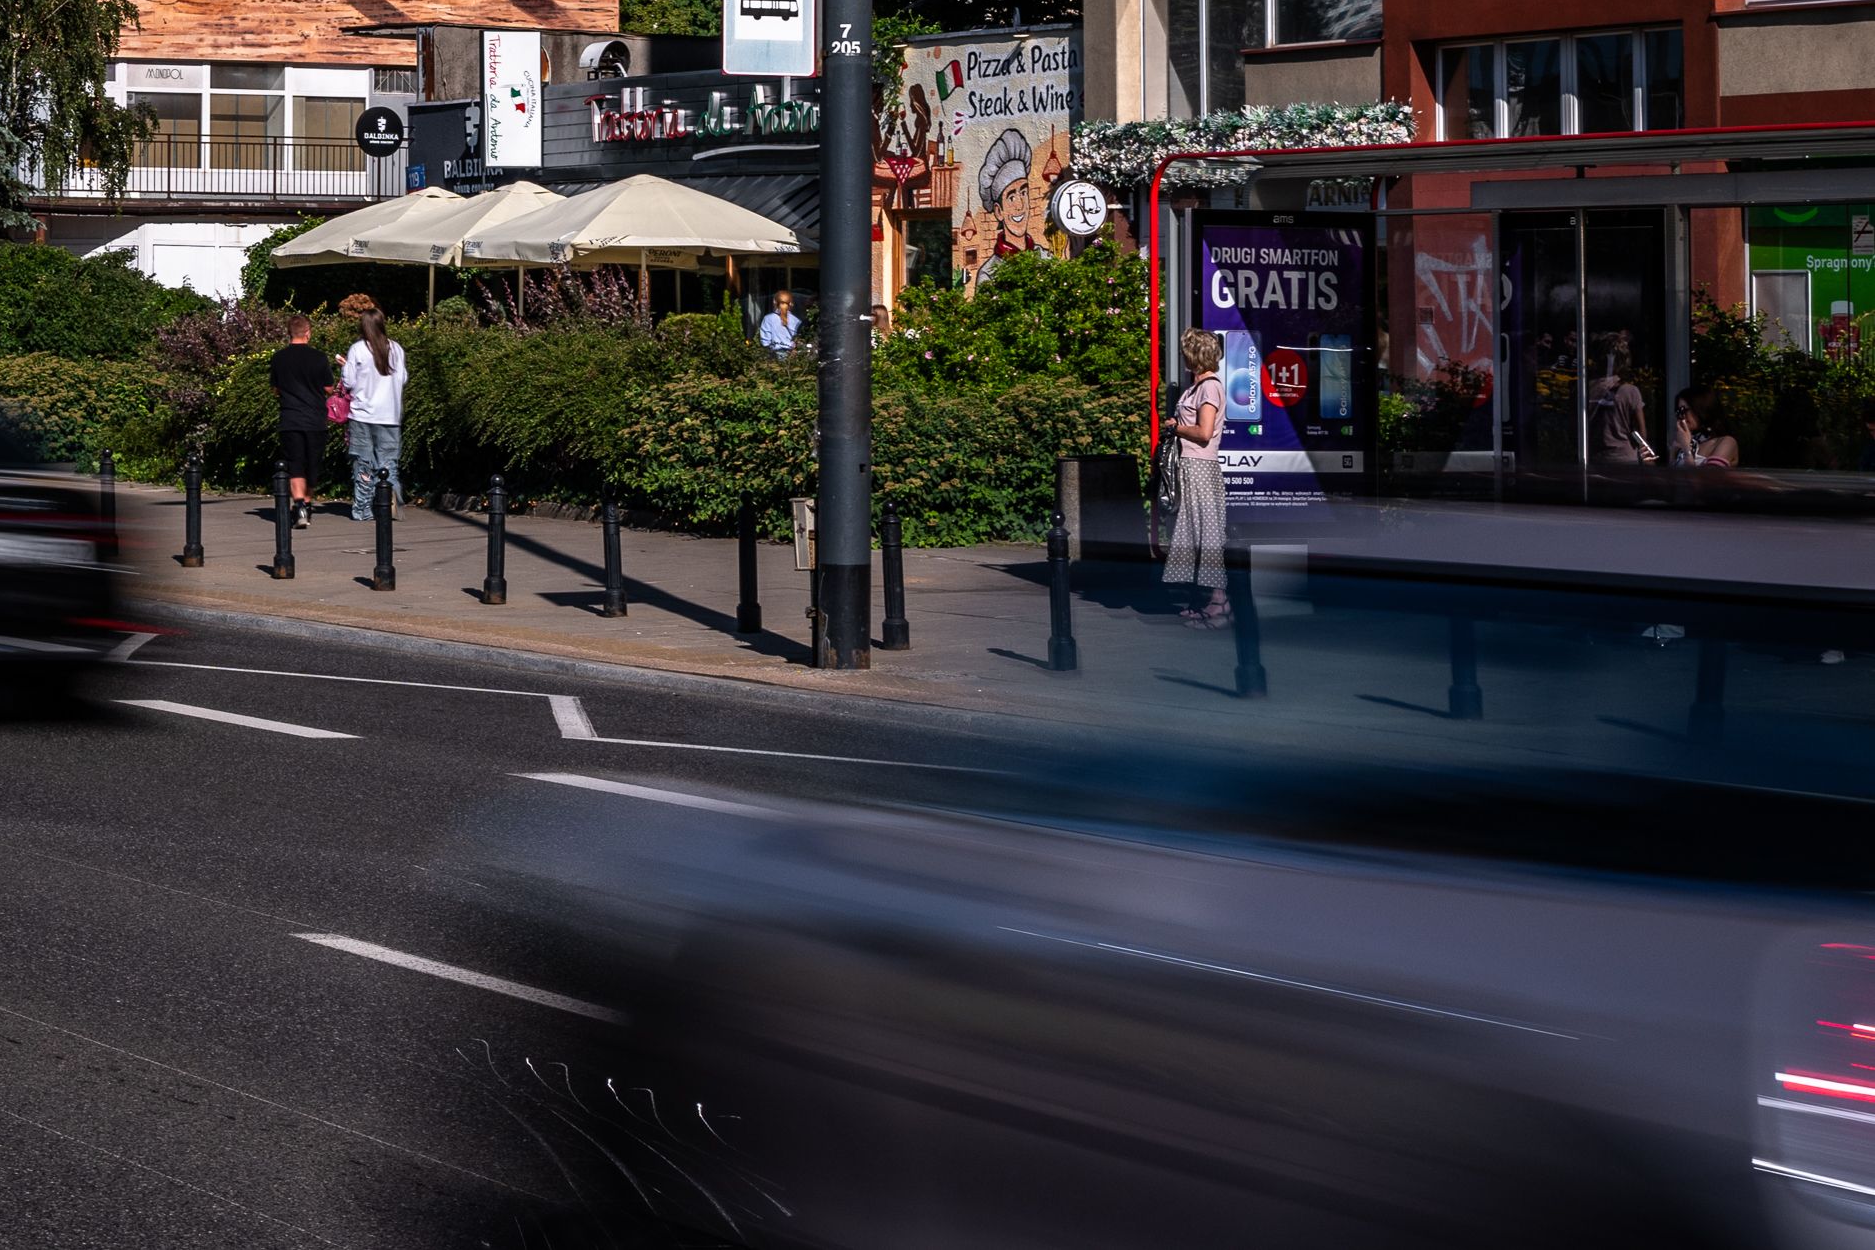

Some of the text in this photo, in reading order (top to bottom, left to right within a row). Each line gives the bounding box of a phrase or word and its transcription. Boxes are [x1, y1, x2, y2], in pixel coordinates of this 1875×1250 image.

[840, 24, 852, 38] 7
[832, 41, 861, 54] 205
[967, 45, 1078, 80] Pizza & Pasta
[967, 85, 1075, 118] Steak & Wine
[1273, 215, 1294, 223] ams
[1211, 247, 1338, 266] DRUGI SMARTFON
[1806, 255, 1875, 272] Spragnony
[1211, 269, 1338, 310] GRATIS
[1248, 346, 1256, 359] 5G
[1268, 363, 1299, 385] 1+1
[1248, 378, 1256, 413] Galaxy
